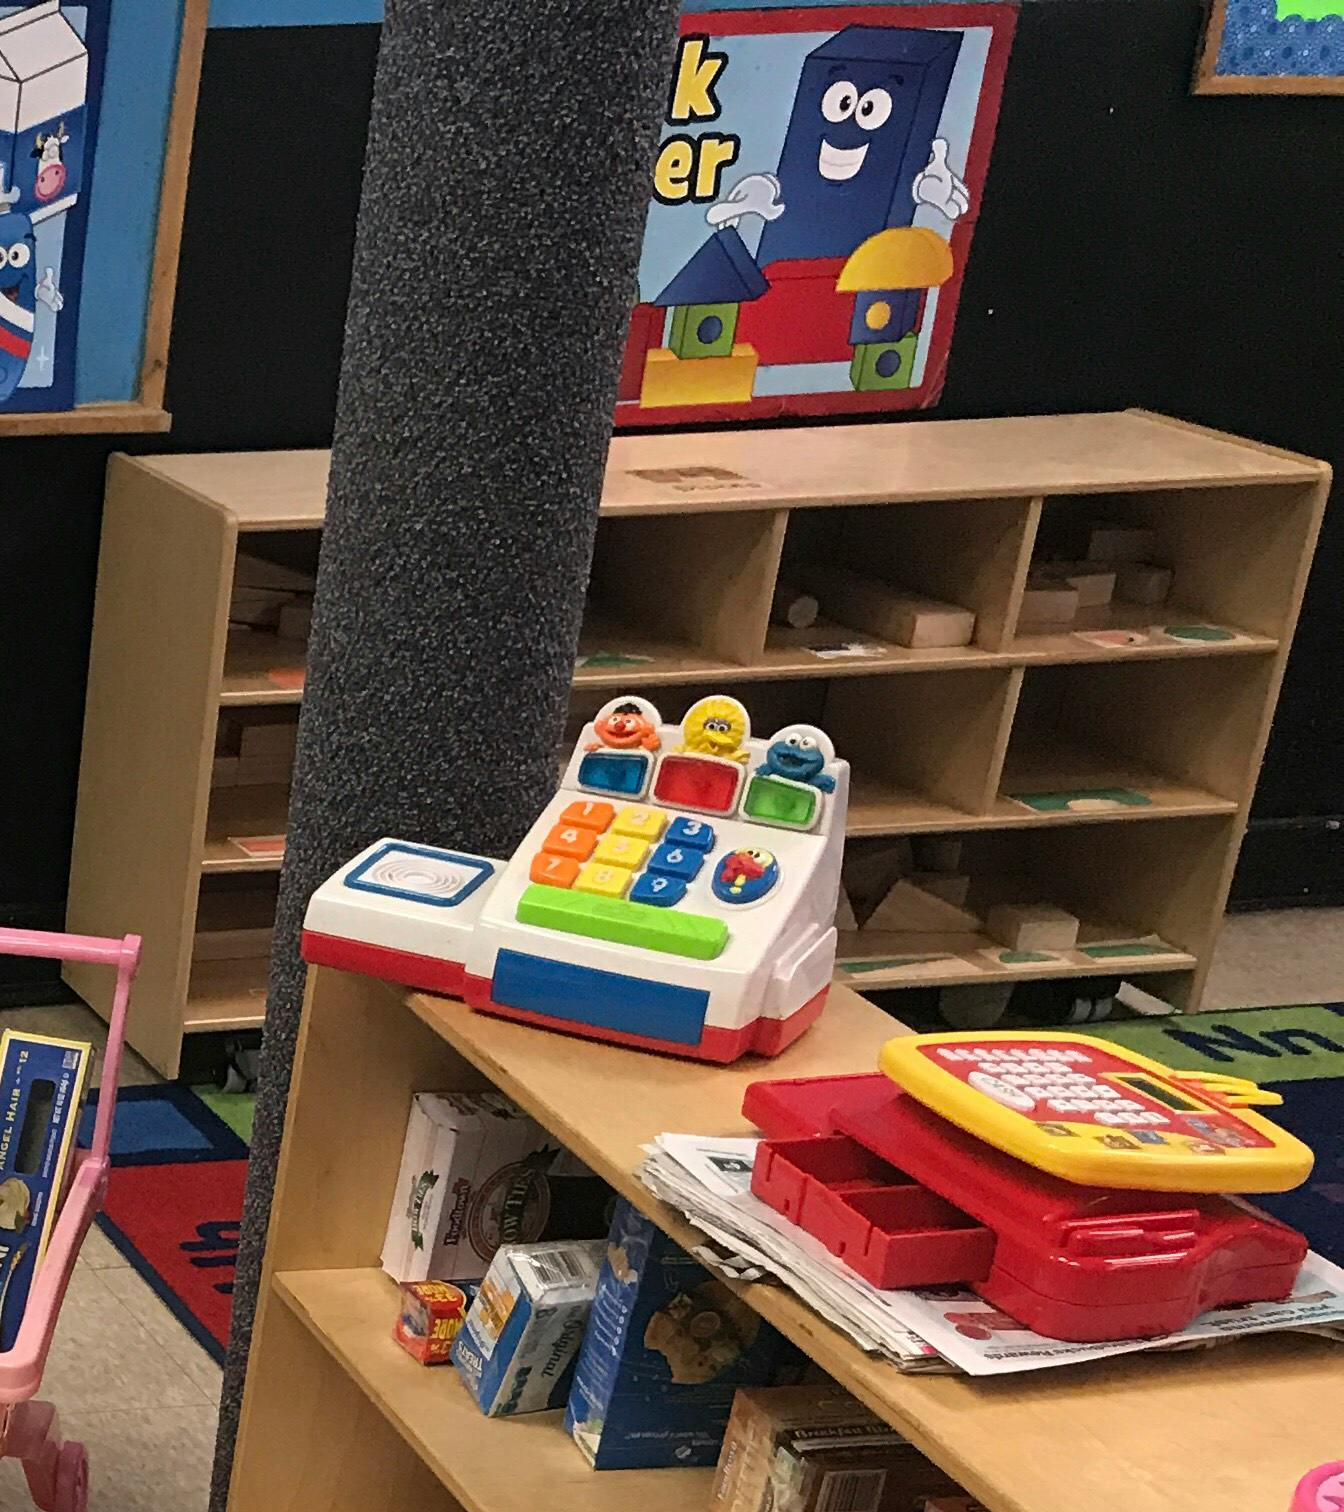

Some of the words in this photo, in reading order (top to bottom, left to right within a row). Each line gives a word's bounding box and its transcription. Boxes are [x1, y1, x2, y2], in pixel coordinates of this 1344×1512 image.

[582, 800, 595, 816] 1
[682, 820, 703, 836] 3
[559, 828, 579, 843] 4
[666, 848, 685, 864] 6
[545, 857, 561, 872] 7
[651, 877, 669, 893] 9
[5, 1088, 21, 1122] HAIR
[503, 1216, 520, 1244] OW
[796, 1427, 862, 1439] Breakfast
